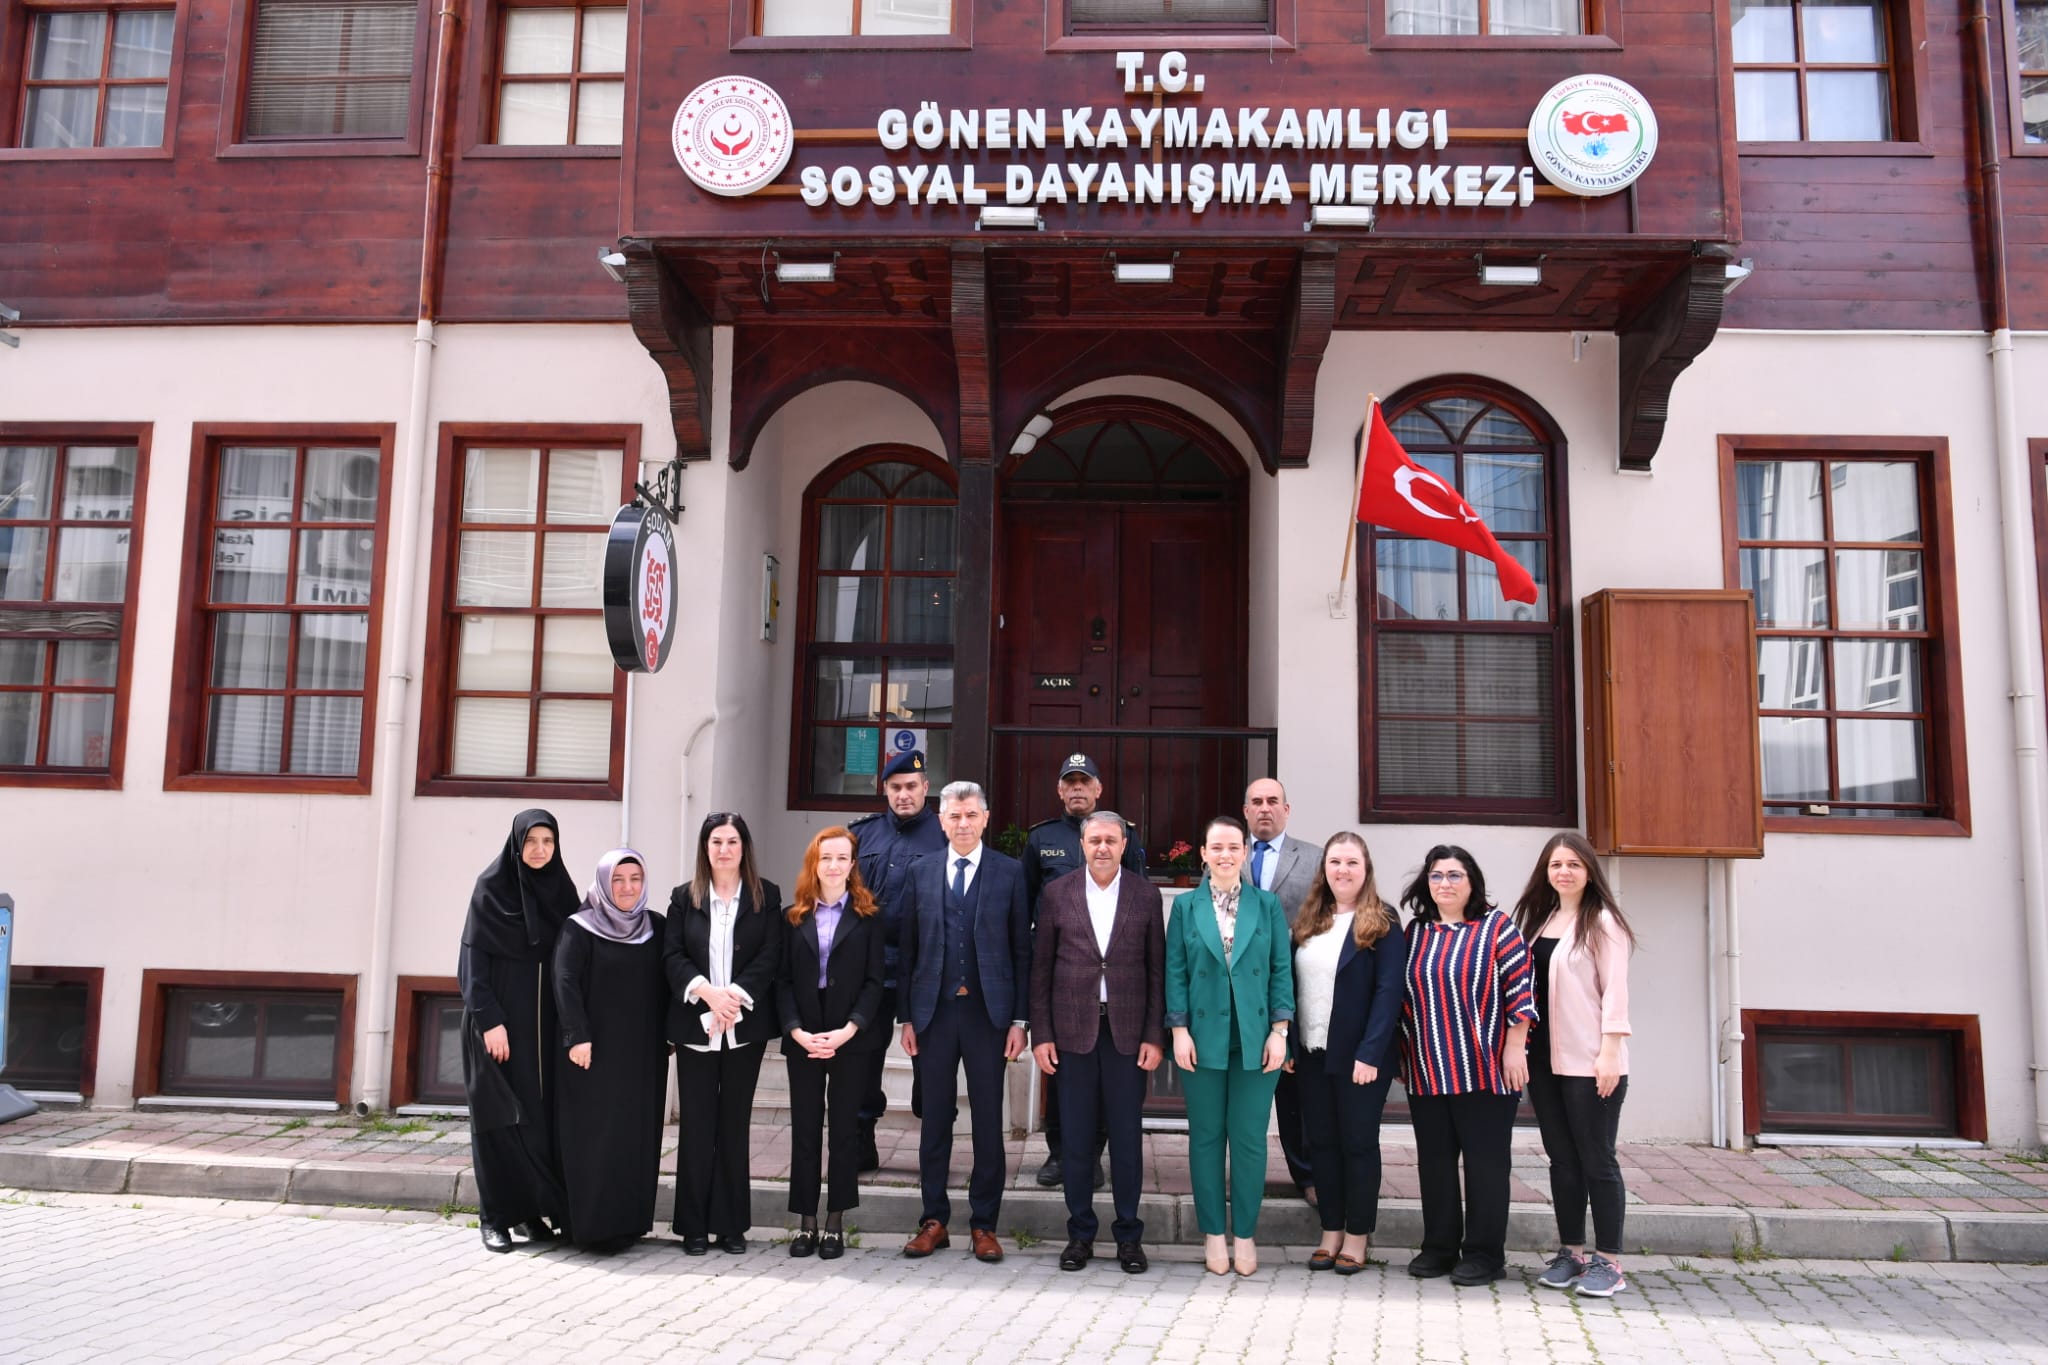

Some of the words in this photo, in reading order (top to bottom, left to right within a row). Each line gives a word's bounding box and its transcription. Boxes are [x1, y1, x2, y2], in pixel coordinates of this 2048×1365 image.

[1116, 51, 1205, 92] T.C.
[877, 101, 1046, 150] GÖNEN
[800, 164, 987, 206] SOSYAL
[1005, 163, 1292, 213] DAYANIŞMA
[1309, 163, 1534, 207] MERKEZİ
[1545, 150, 1574, 179] GÖNEN
[1575, 151, 1648, 186] KAYMAKAMLIĞI
[647, 512, 672, 552] SODAM
[1041, 678, 1071, 688] AÇIK
